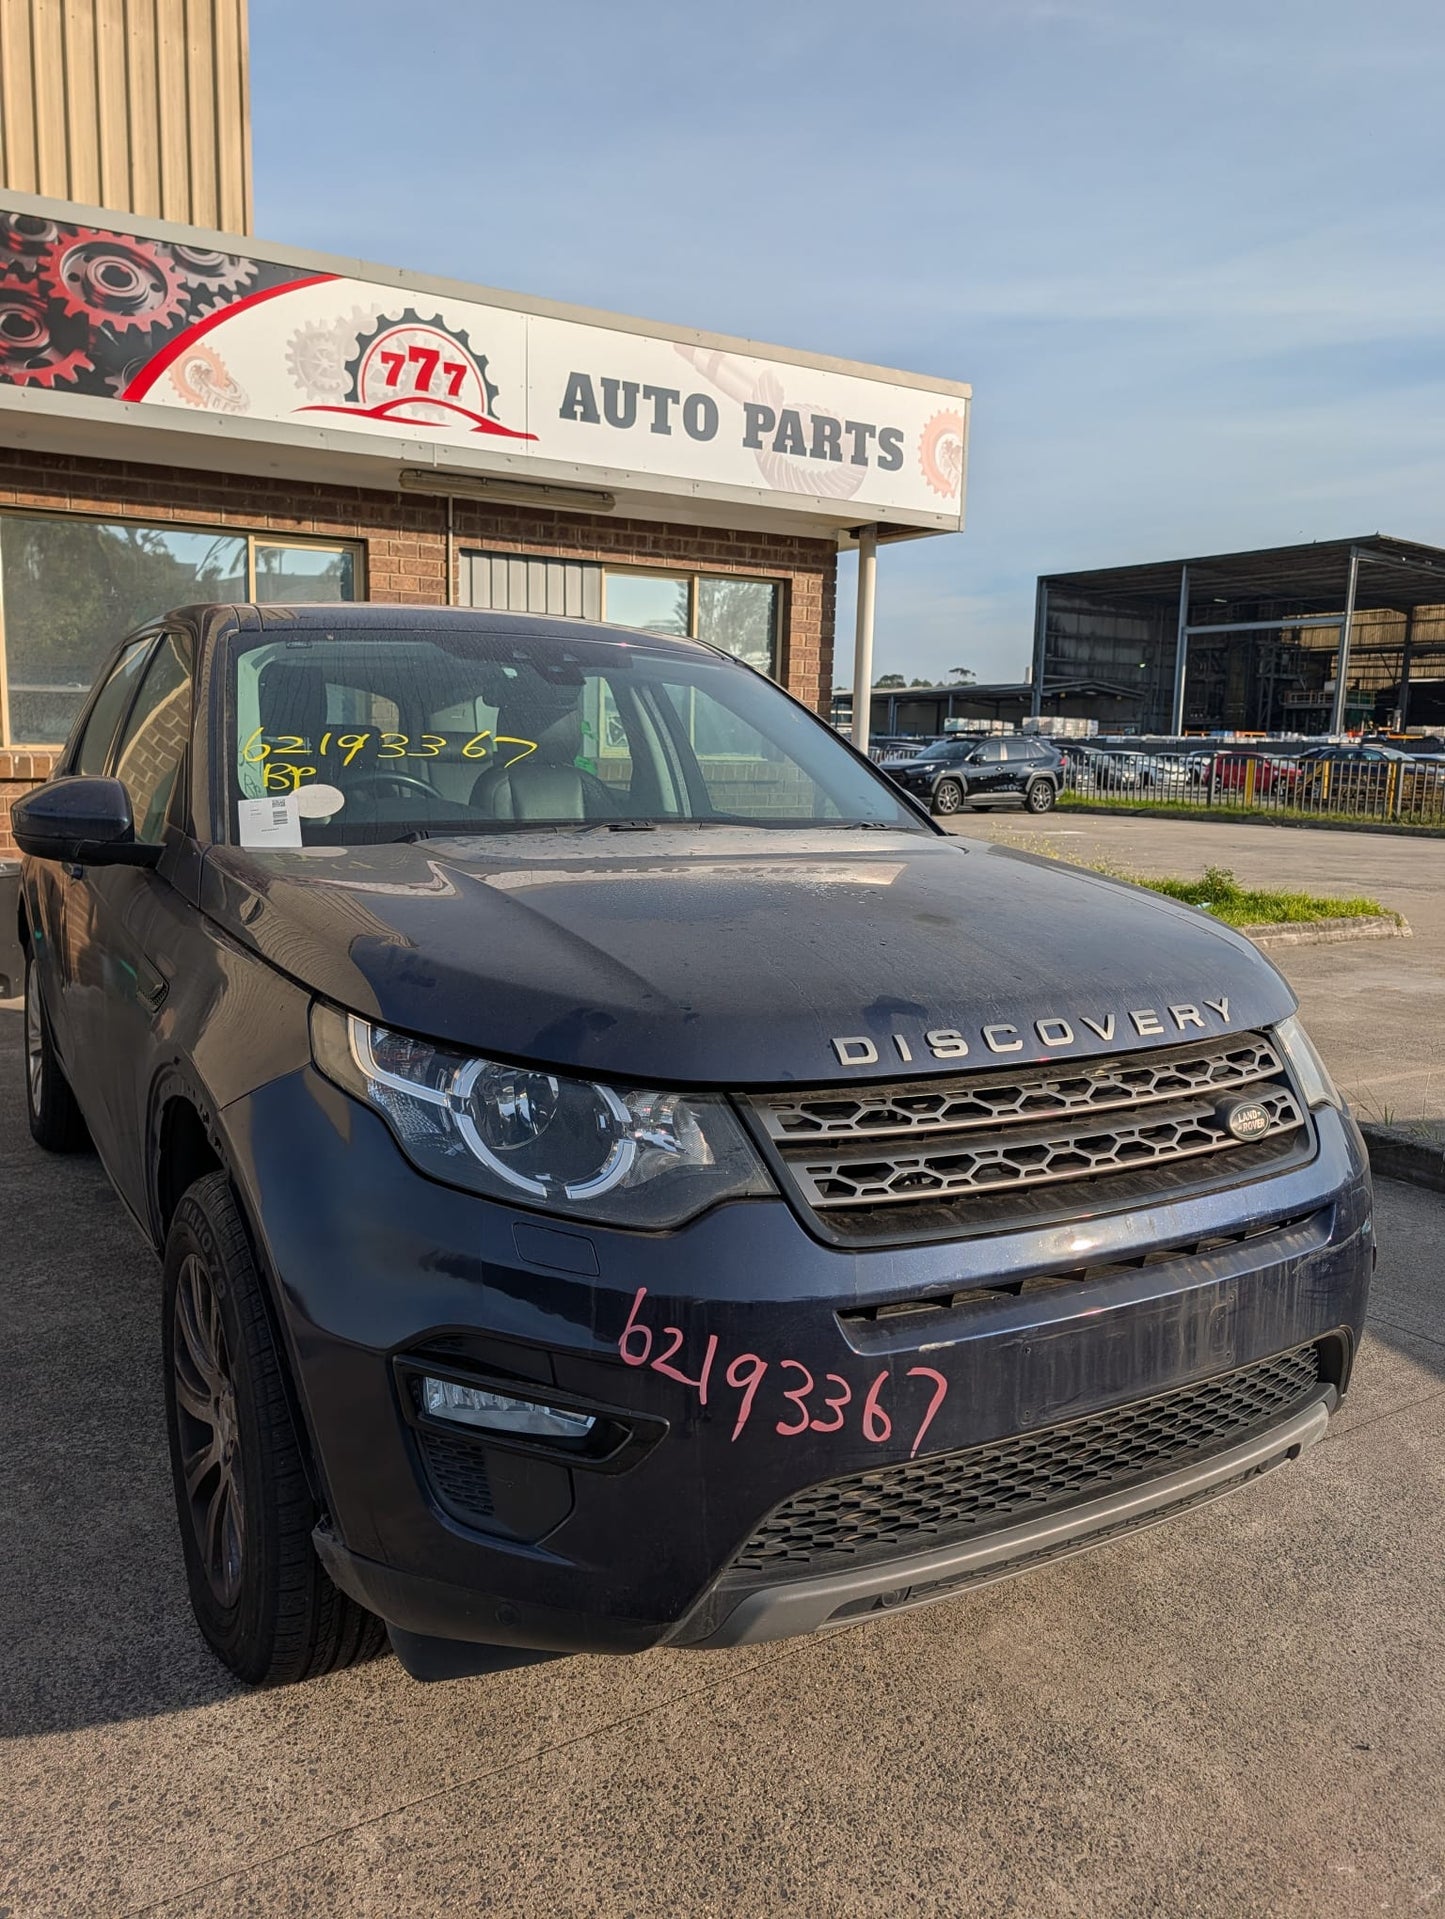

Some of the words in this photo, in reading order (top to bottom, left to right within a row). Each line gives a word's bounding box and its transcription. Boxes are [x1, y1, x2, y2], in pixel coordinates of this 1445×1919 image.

[380, 346, 468, 398] 777
[559, 371, 720, 443] AUTO
[742, 402, 905, 472] PARTS
[242, 727, 538, 768] 62193367
[831, 998, 1231, 1066] DISCOVERY
[1237, 1110, 1258, 1123] LAND
[1242, 1118, 1265, 1132] ROVER
[618, 1287, 948, 1459] 62193367
